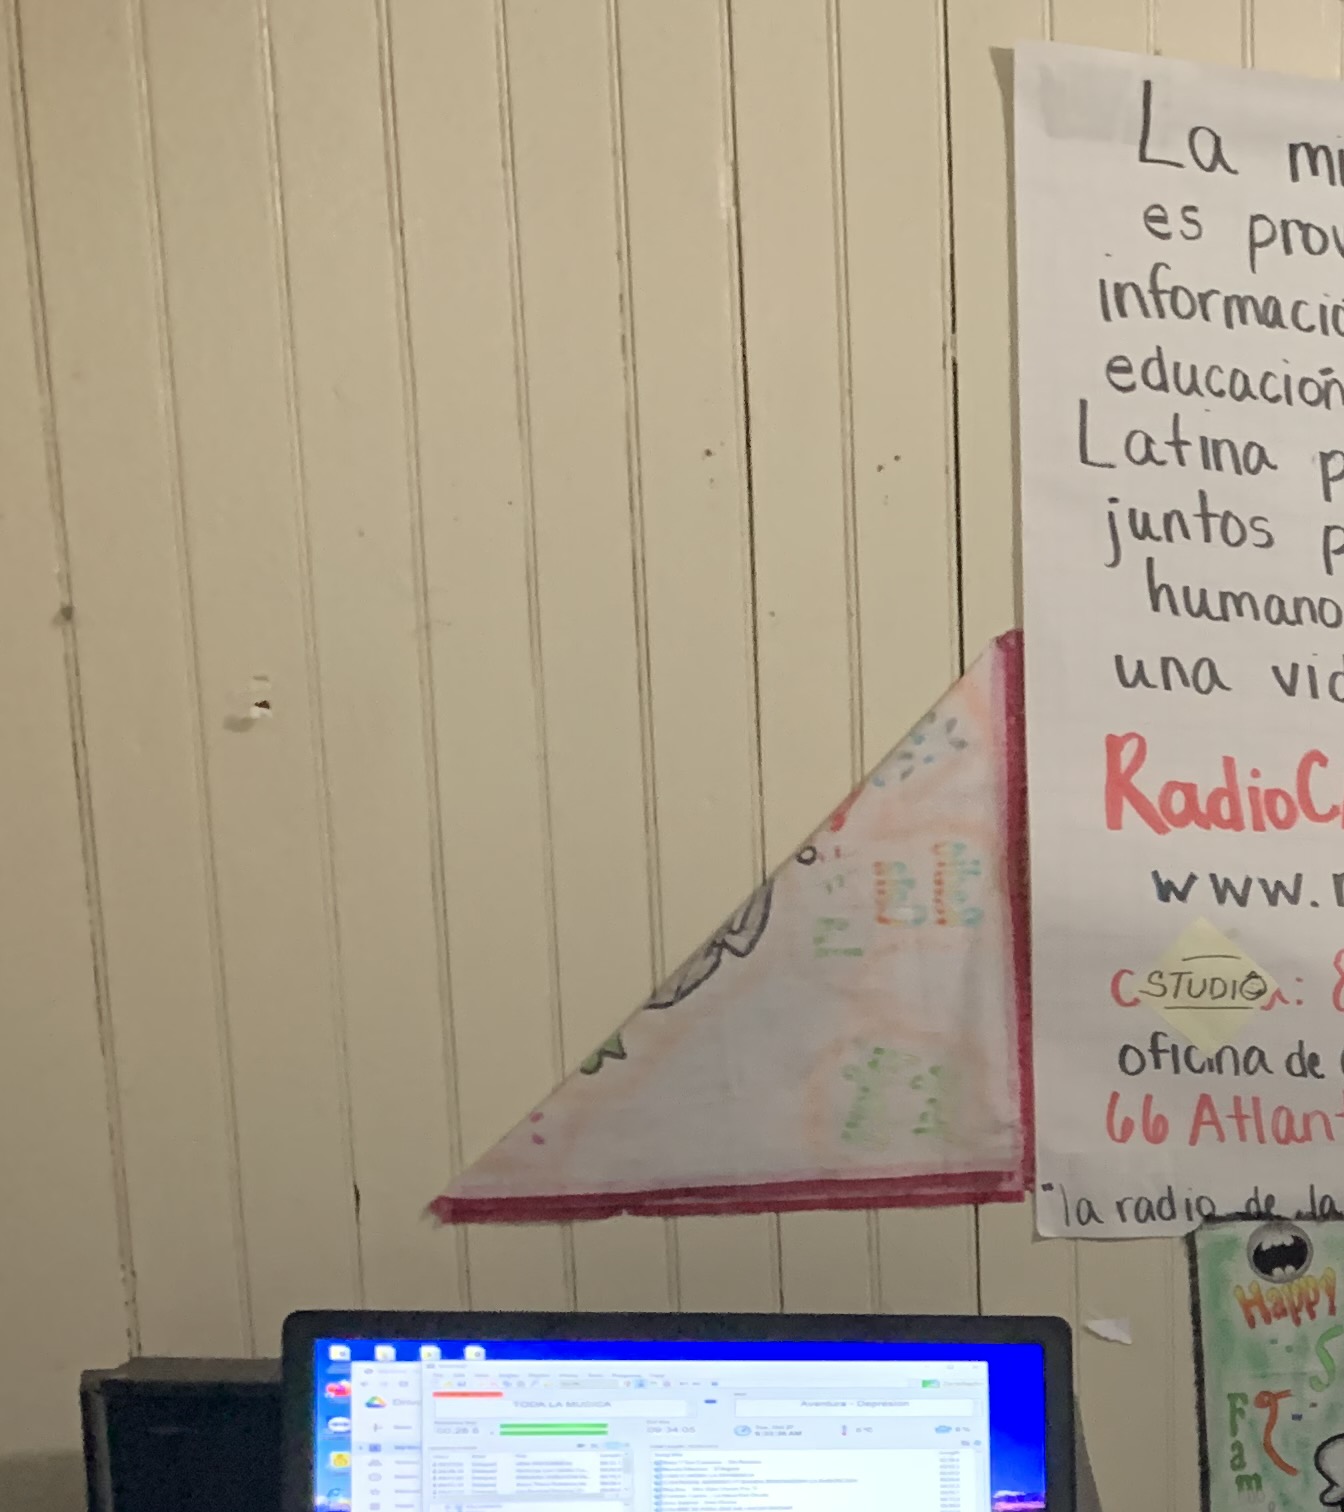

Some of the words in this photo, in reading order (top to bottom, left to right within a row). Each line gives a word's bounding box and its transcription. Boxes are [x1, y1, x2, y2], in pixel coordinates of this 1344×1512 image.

[1139, 80, 1239, 175] La
[1143, 204, 1202, 240] es
[1079, 399, 1278, 475] Latina
[1105, 489, 1274, 568] juntos
[1146, 557, 1343, 628] humano
[1115, 655, 1232, 695] una
[1139, 971, 1267, 1001] STUDIO
[1119, 1031, 1274, 1076] oficina
[1285, 1040, 1325, 1079] de
[1107, 1091, 1168, 1144] 66
[1116, 1186, 1214, 1223] radio
[1245, 1187, 1277, 1221] de
[1309, 1184, 1338, 1222] la
[1233, 1266, 1336, 1329] Happy
